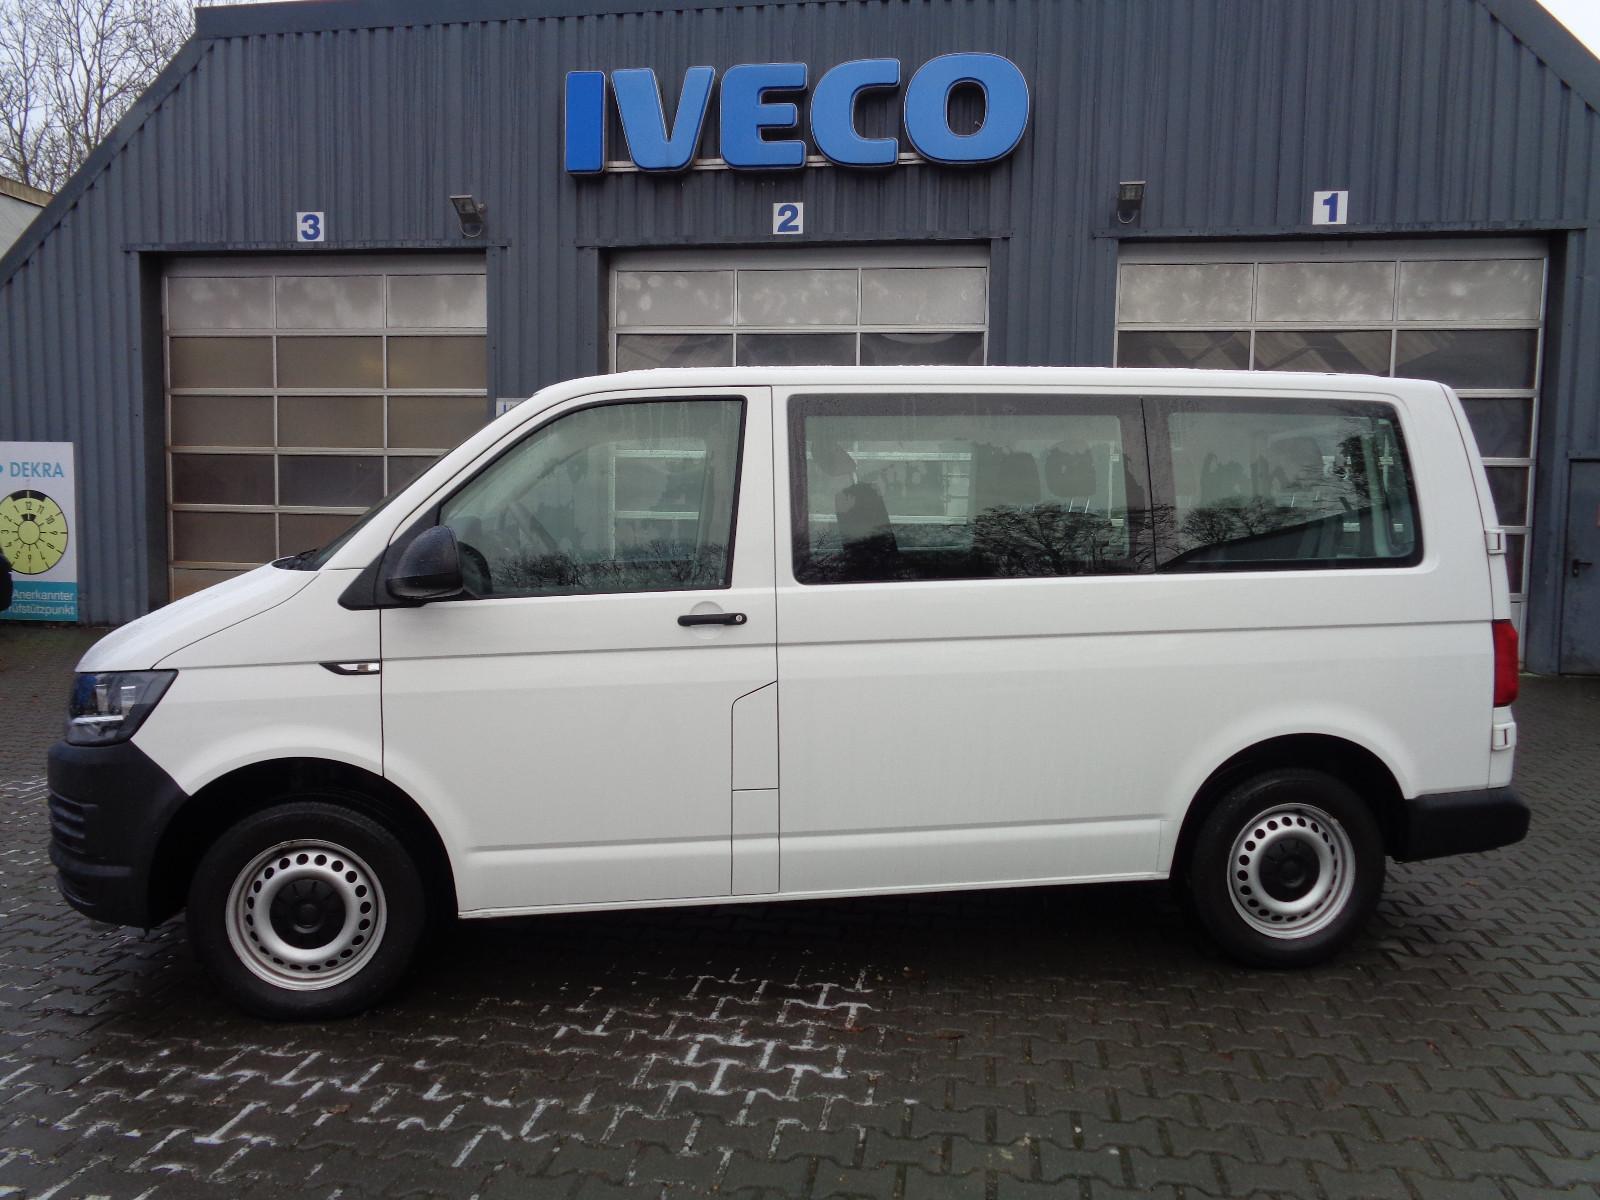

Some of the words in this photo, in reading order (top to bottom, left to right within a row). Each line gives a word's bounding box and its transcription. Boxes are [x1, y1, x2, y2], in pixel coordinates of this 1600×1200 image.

[565, 52, 1029, 174] IVECO
[1323, 193, 1338, 222] 1
[777, 204, 800, 232] 2
[301, 214, 320, 240] 3
[10, 461, 64, 478] DEKRA
[25, 501, 32, 510] 12
[37, 505, 45, 514] 11
[46, 515, 55, 524] 10
[13, 588, 73, 601] Anerkannter
[8, 603, 74, 616] rüfstützpunkt
